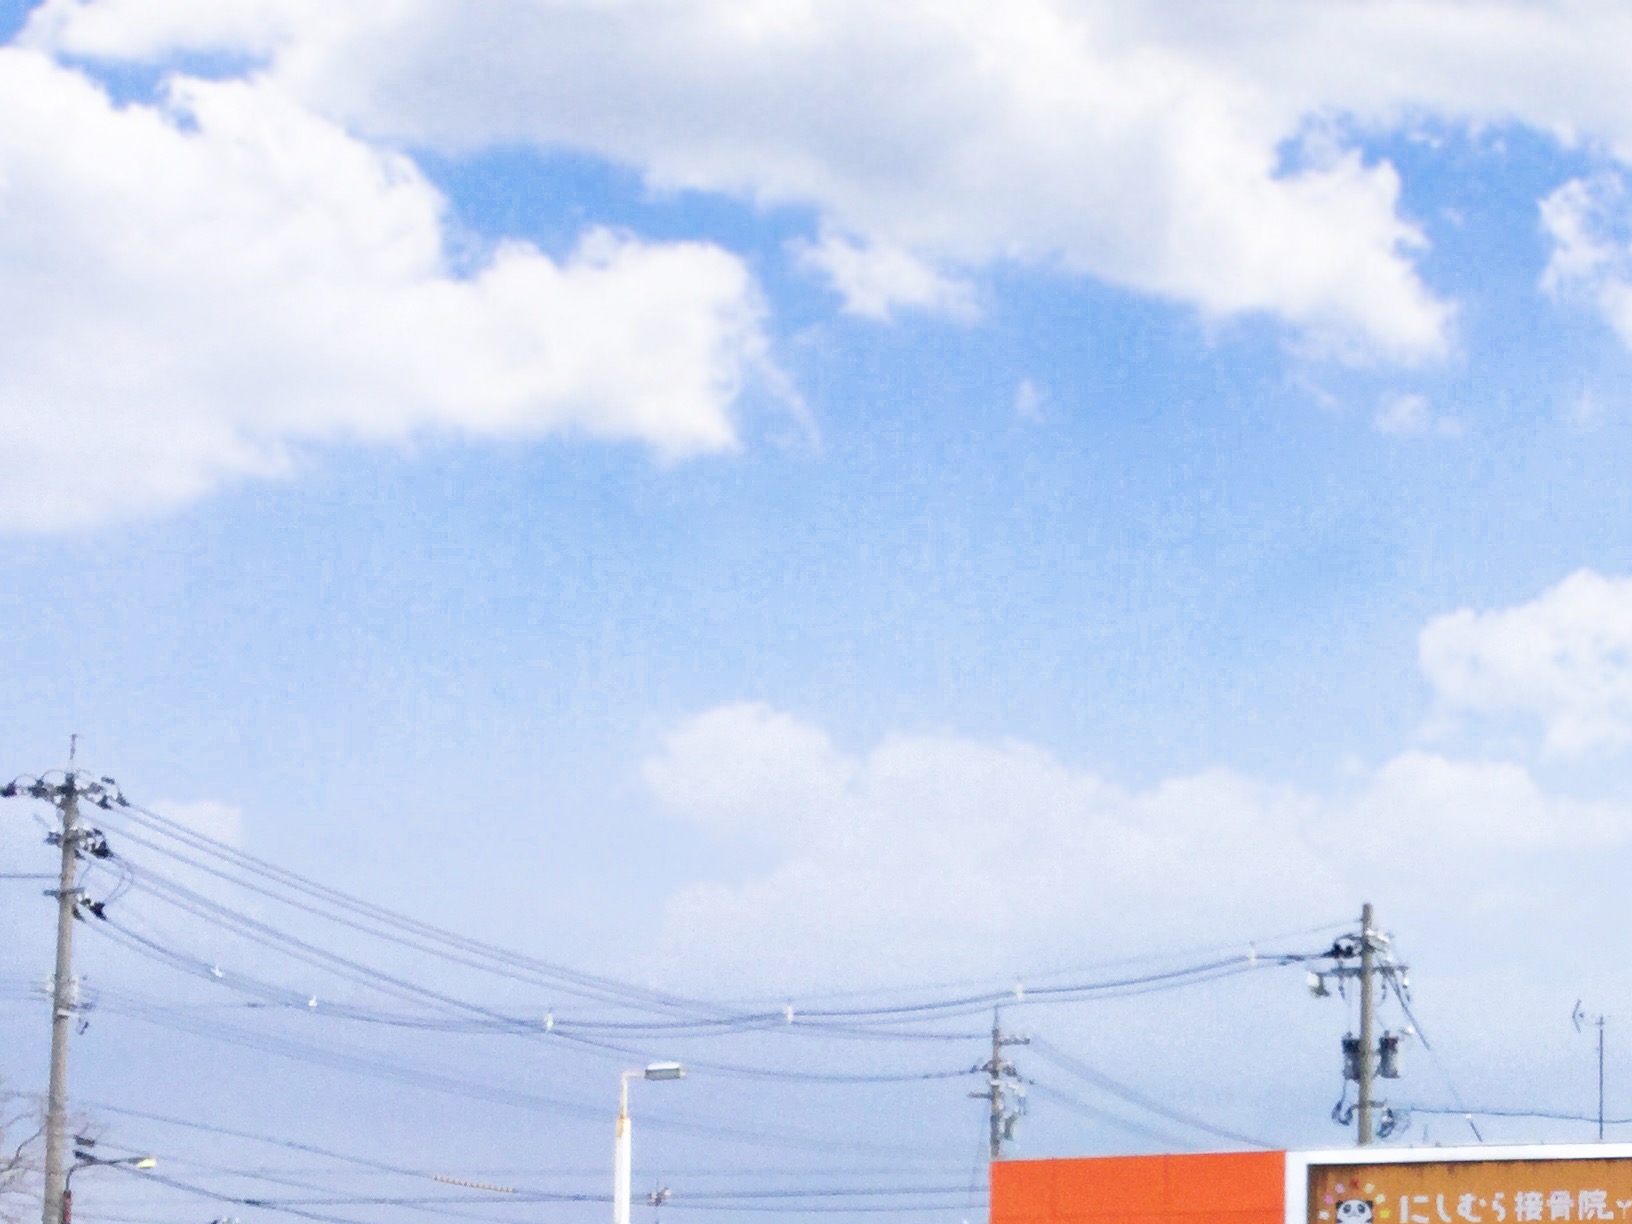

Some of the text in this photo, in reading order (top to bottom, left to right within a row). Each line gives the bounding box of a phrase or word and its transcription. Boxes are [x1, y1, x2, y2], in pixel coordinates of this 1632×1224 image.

[1400, 1190, 1614, 1224] にしむら接骨院
